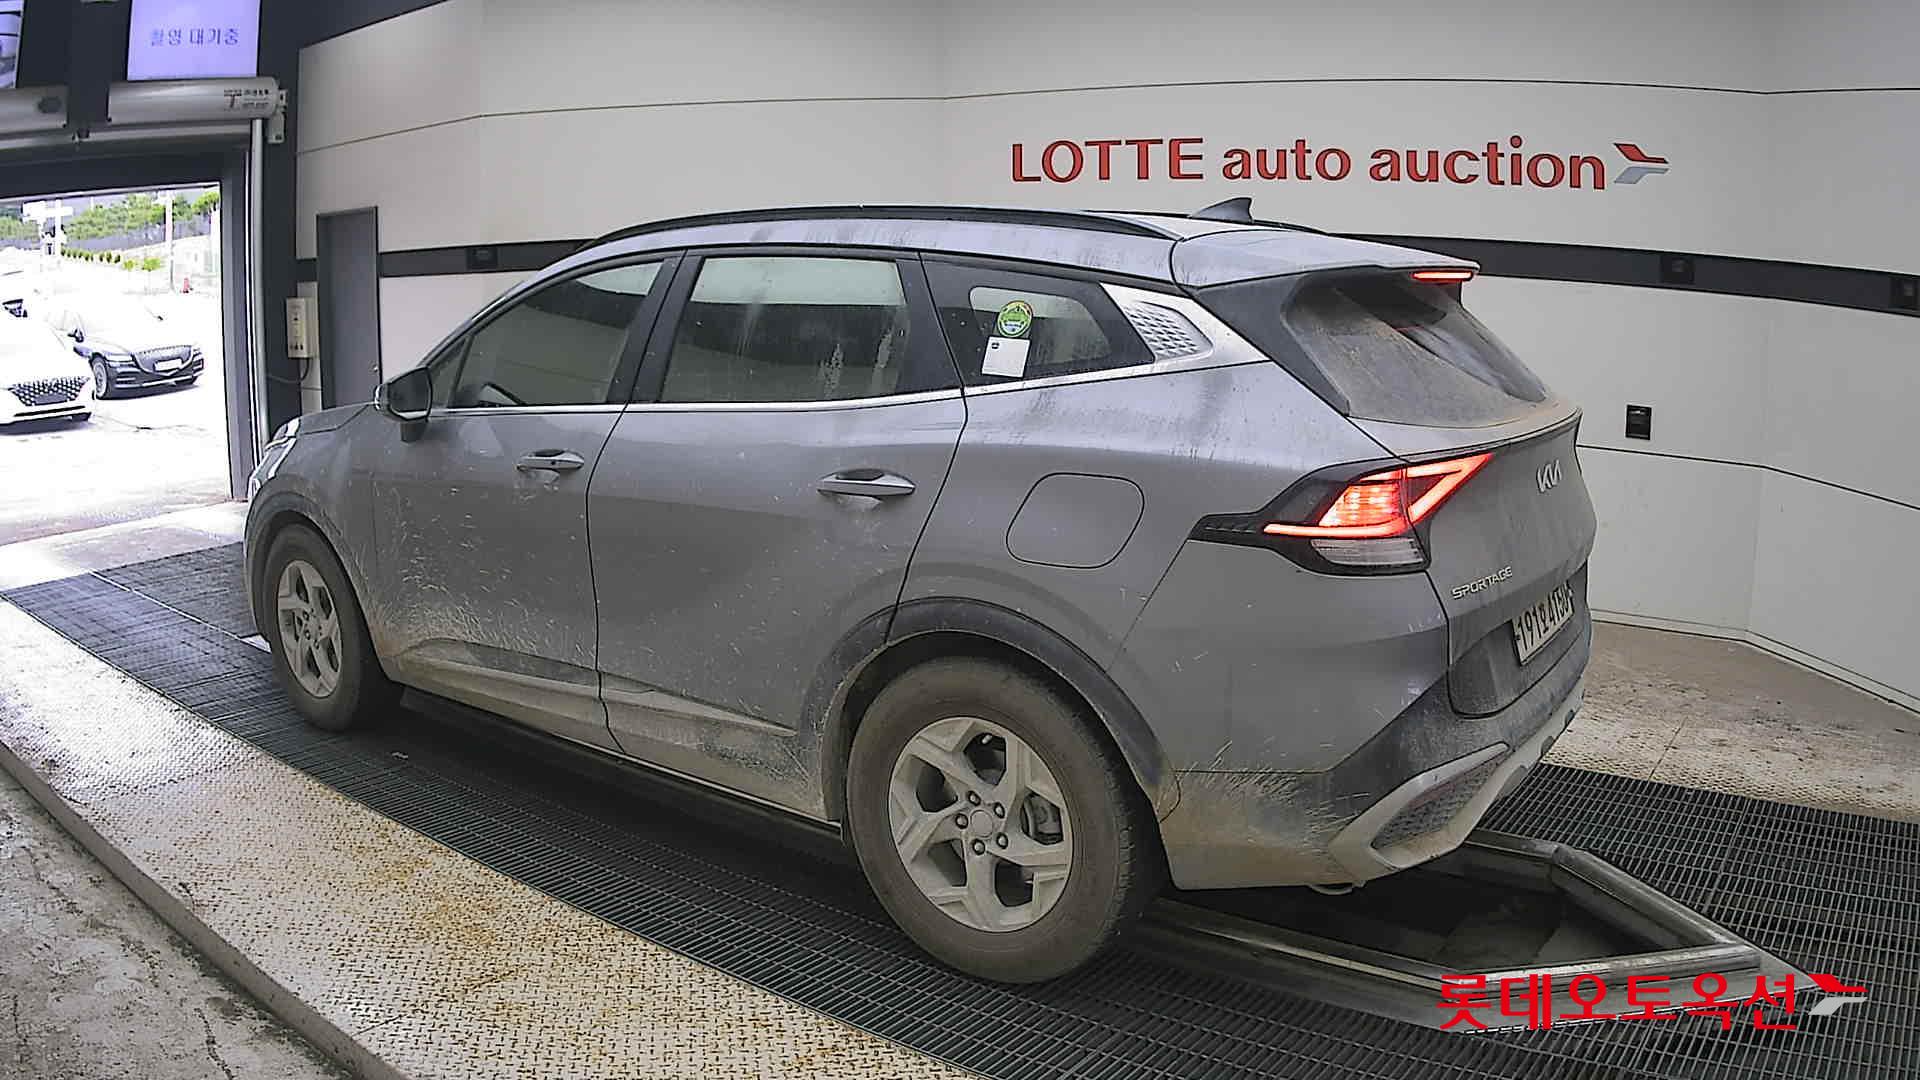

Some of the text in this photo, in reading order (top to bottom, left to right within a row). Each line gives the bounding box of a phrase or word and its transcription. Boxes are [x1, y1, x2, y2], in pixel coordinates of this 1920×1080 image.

[190, 28, 239, 46] 대기중
[1012, 135, 1605, 190] LOTTE auto auction
[1536, 459, 1563, 494] KIA
[1452, 565, 1513, 600] SPORTAGE
